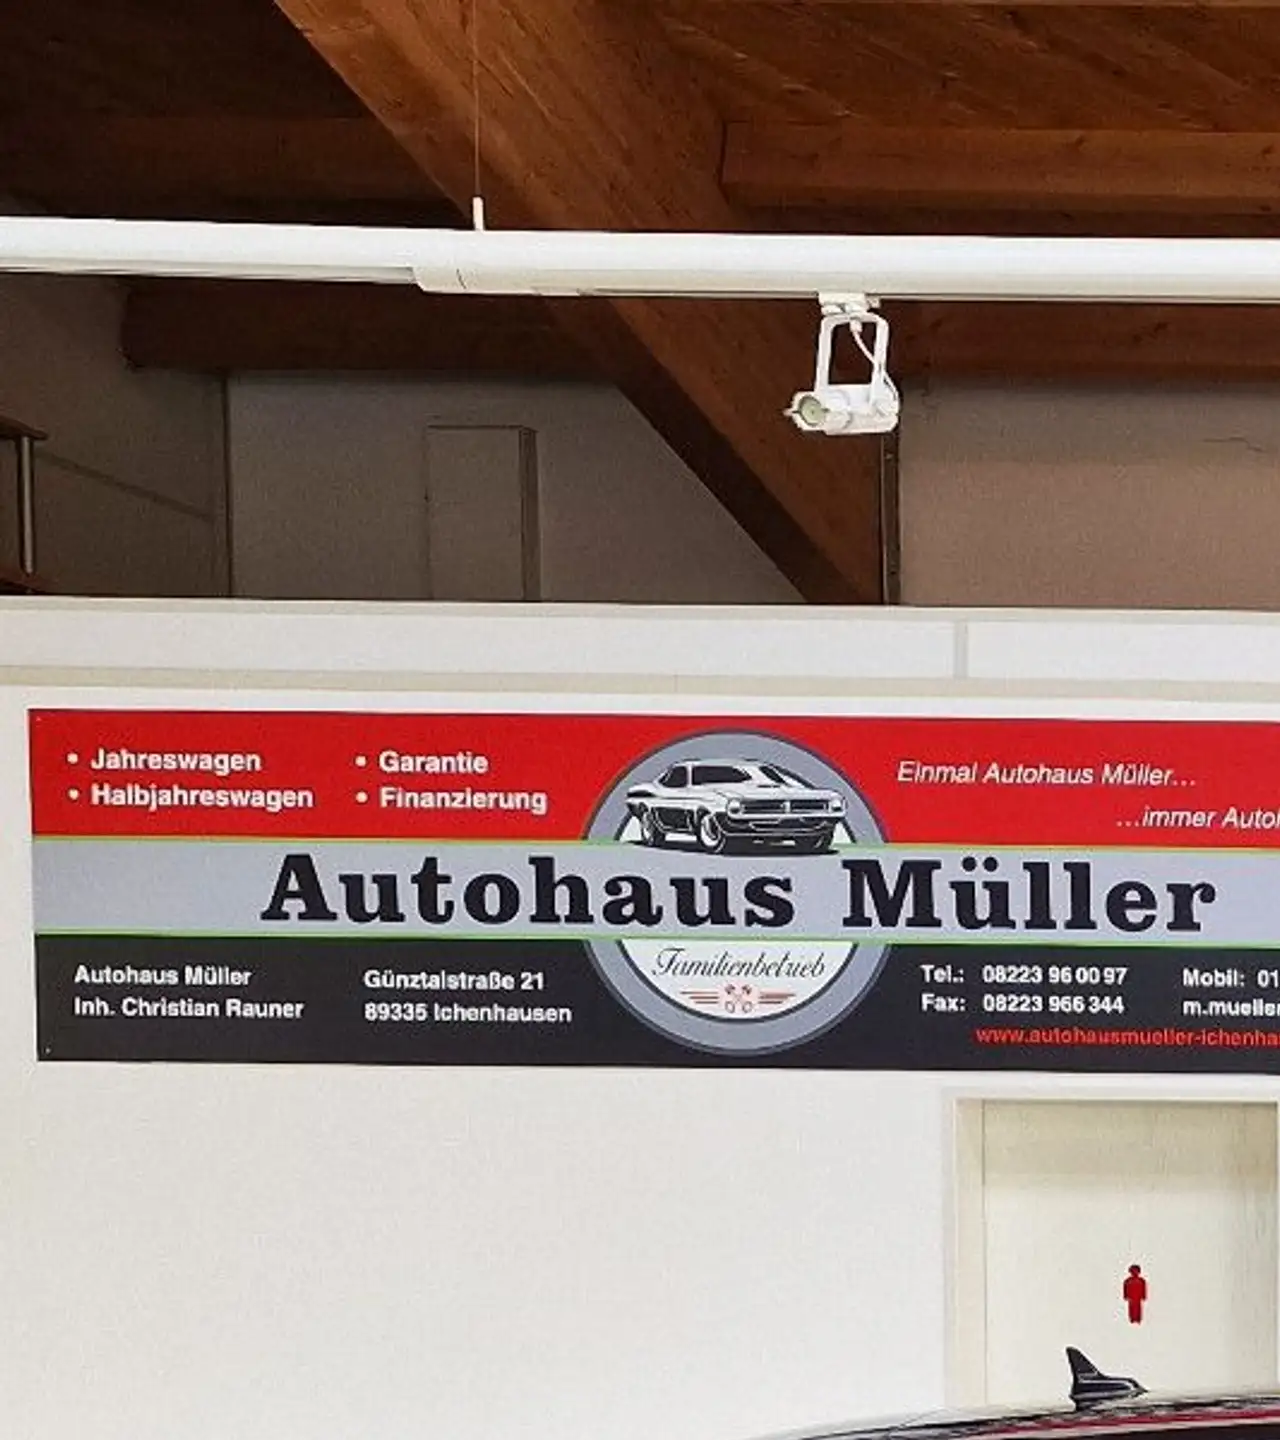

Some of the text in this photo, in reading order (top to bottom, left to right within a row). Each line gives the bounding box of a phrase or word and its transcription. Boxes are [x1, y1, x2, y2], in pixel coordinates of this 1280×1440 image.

[91, 748, 261, 775] Jahreswagen
[379, 751, 489, 774] Garantie
[897, 761, 976, 783] Einmal
[982, 762, 1094, 784] Autohaus
[91, 783, 314, 812] Halbjahreswagen
[380, 787, 548, 815] Finanzierung
[260, 853, 1216, 932] Autohaus Müller
[652, 948, 826, 979] Familienbetrieb
[920, 965, 965, 983] Tel.:
[982, 965, 1043, 984] 08223
[74, 965, 252, 986] Autohaus Müller
[363, 970, 544, 991] Günztalstraße 21
[1183, 968, 1245, 988] Mobil:
[74, 997, 304, 1018] Inh. Christian Rauner
[365, 1003, 572, 1023] 89335 Ichenhausen
[921, 993, 966, 1012] Fax:
[983, 994, 1043, 1013] 08223
